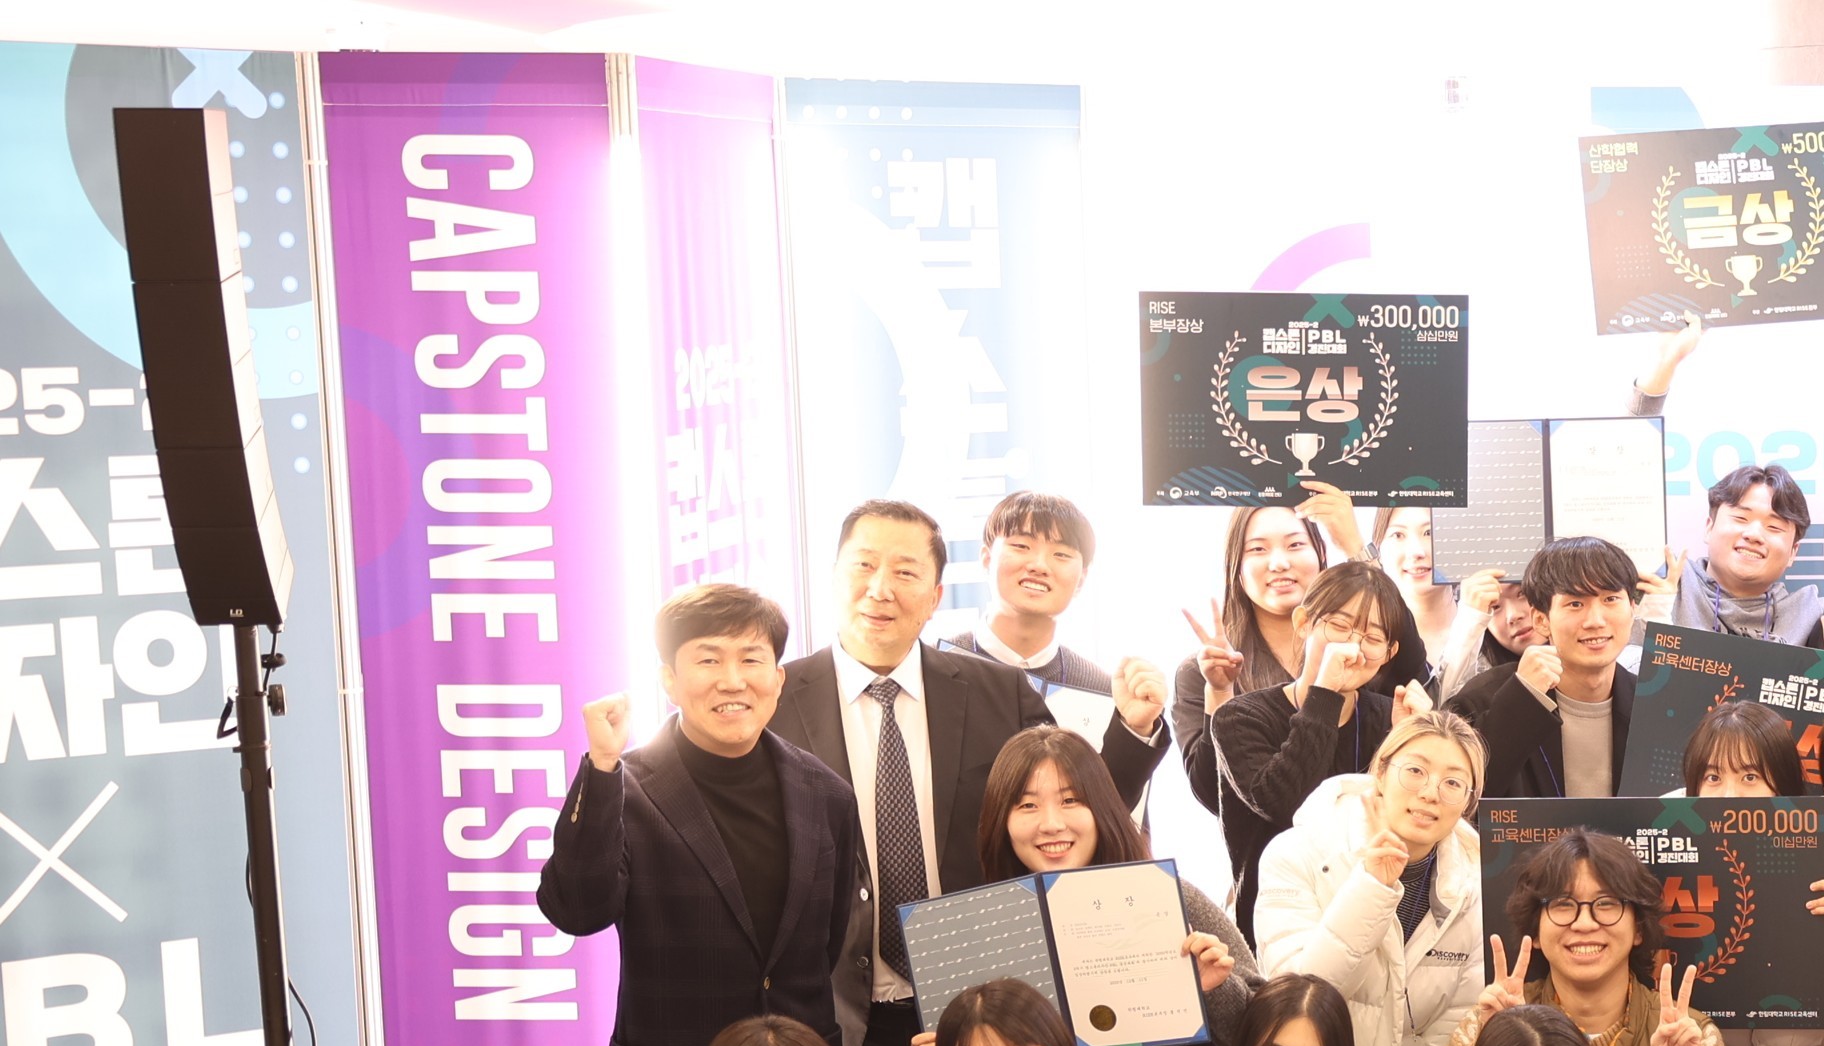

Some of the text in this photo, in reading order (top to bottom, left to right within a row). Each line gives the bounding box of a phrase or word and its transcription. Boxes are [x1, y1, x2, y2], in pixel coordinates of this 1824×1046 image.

[1589, 142, 1639, 158] 산학협력
[1590, 159, 1628, 174] 단장상
[1737, 158, 1773, 172] PBL
[1683, 190, 1794, 249] 금상
[1149, 301, 1175, 314] RISE
[1357, 304, 1459, 331] ₩300,000
[1149, 319, 1204, 333] 본부장상
[1263, 329, 1301, 341] 캡스톤
[1308, 330, 1346, 343] PBL
[1417, 331, 1458, 342] 삼십만원
[1263, 341, 1301, 354] 디자인
[1246, 366, 1363, 422] 은상
[402, 134, 578, 1020] CAPSTONE DESIGN
[1655, 633, 1681, 650] RISE
[1652, 651, 1732, 676] 교육센터장상
[1760, 678, 1798, 694] 캡스톤
[1788, 675, 1819, 685] 2025-2
[1759, 690, 1797, 709] 디자인
[1490, 810, 1518, 823] RISE
[1710, 809, 1818, 836] ₩200,000
[1657, 837, 1698, 851] PBL
[1773, 836, 1818, 848] 이십만원
[1657, 852, 1698, 863] 경진대회
[1663, 876, 1719, 938] 상
